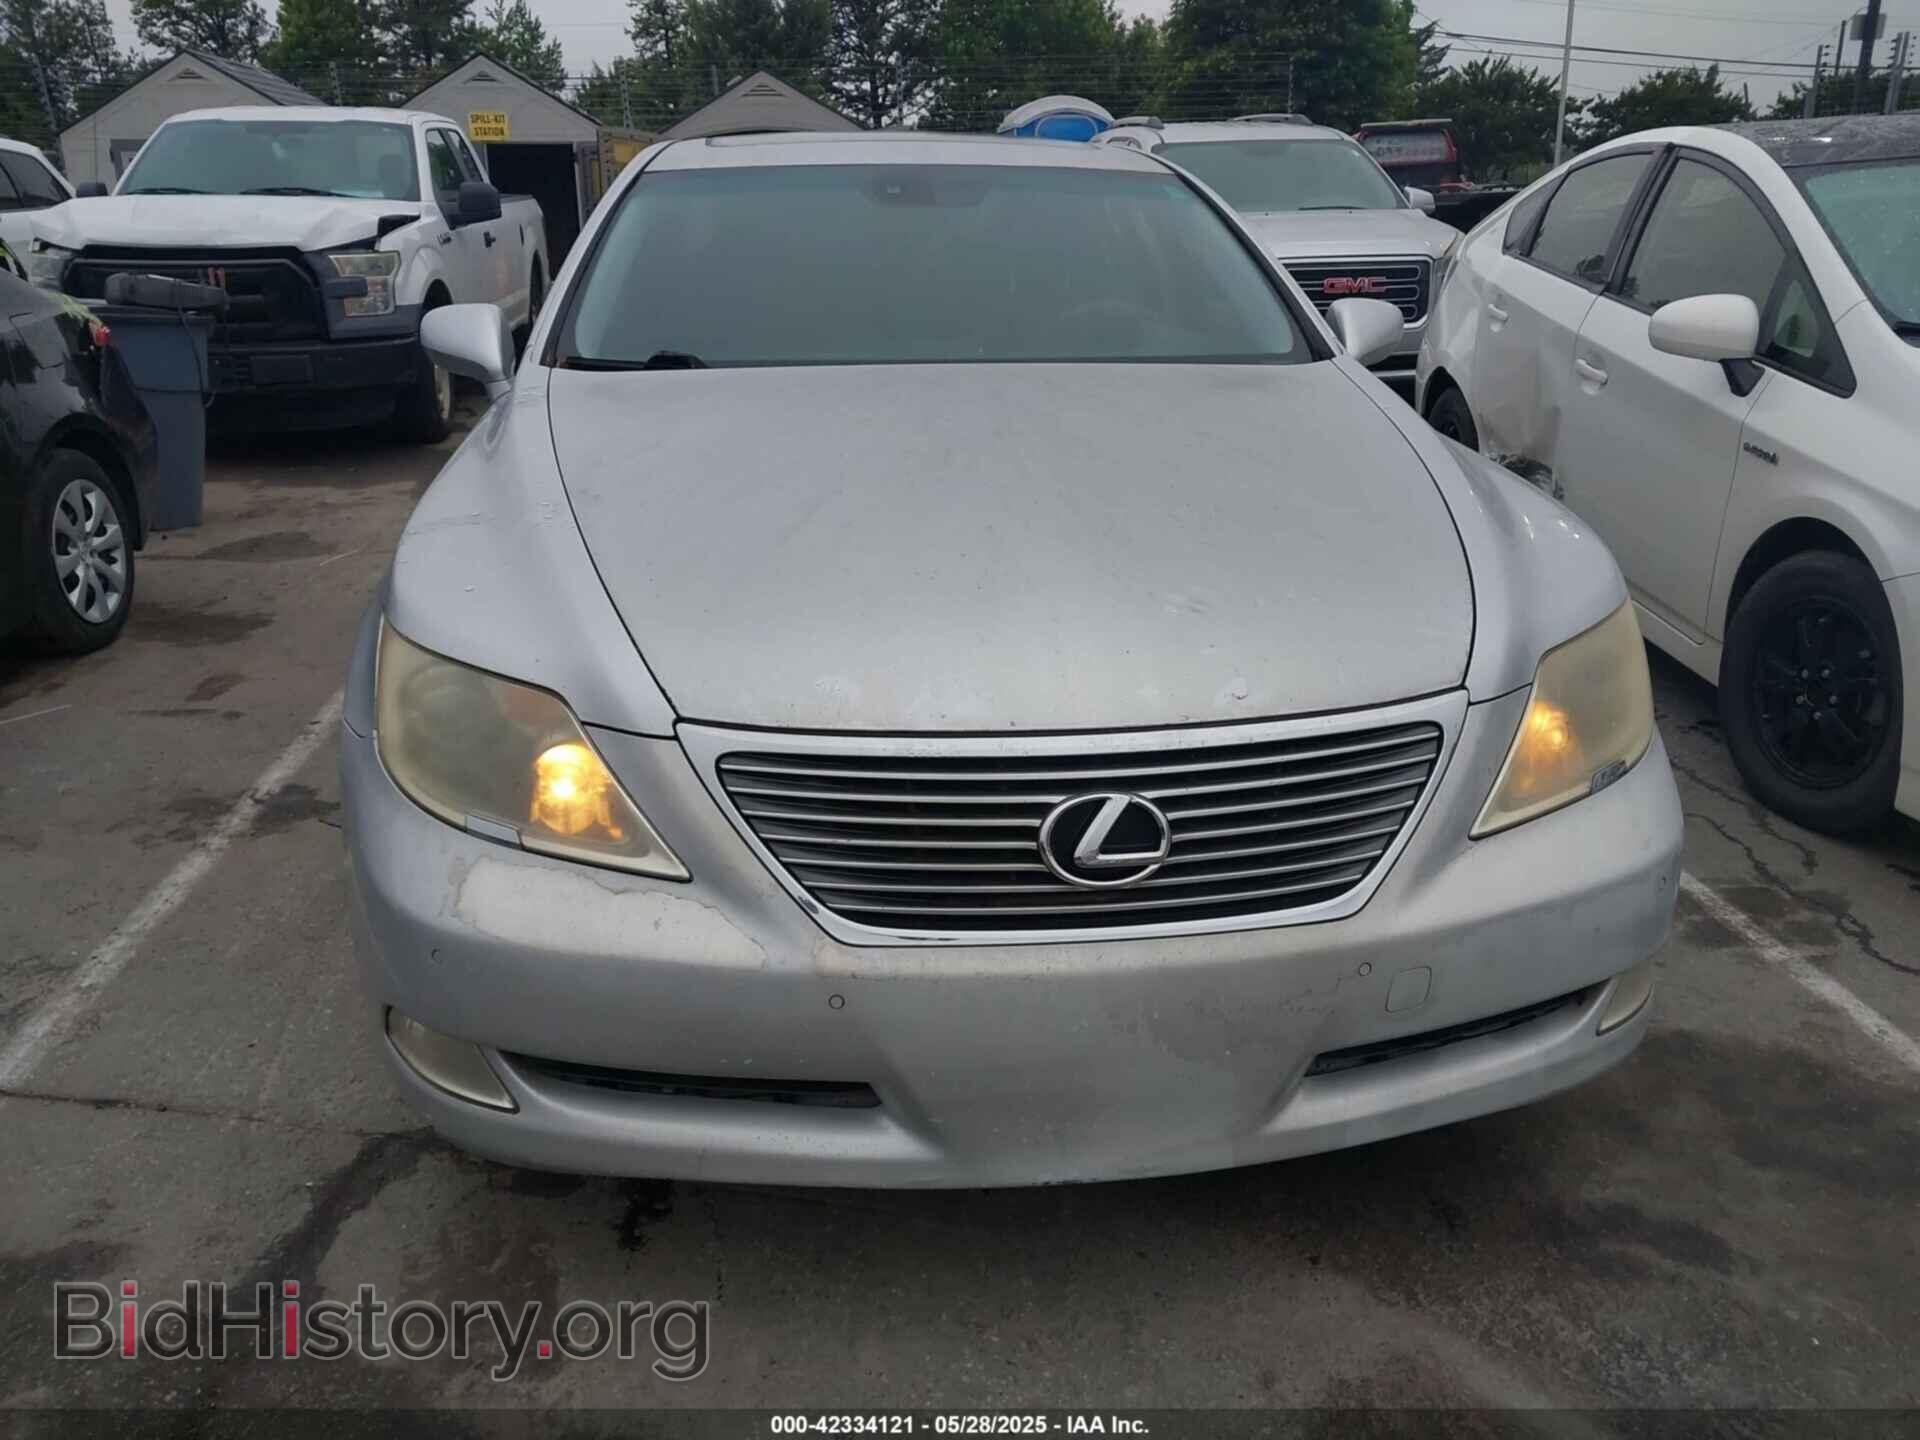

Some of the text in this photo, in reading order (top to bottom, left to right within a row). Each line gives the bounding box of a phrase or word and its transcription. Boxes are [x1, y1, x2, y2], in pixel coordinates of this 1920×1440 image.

[470, 114, 505, 124] SPILL-KIT
[474, 126, 505, 136] STATION
[1323, 276, 1387, 294] GMC
